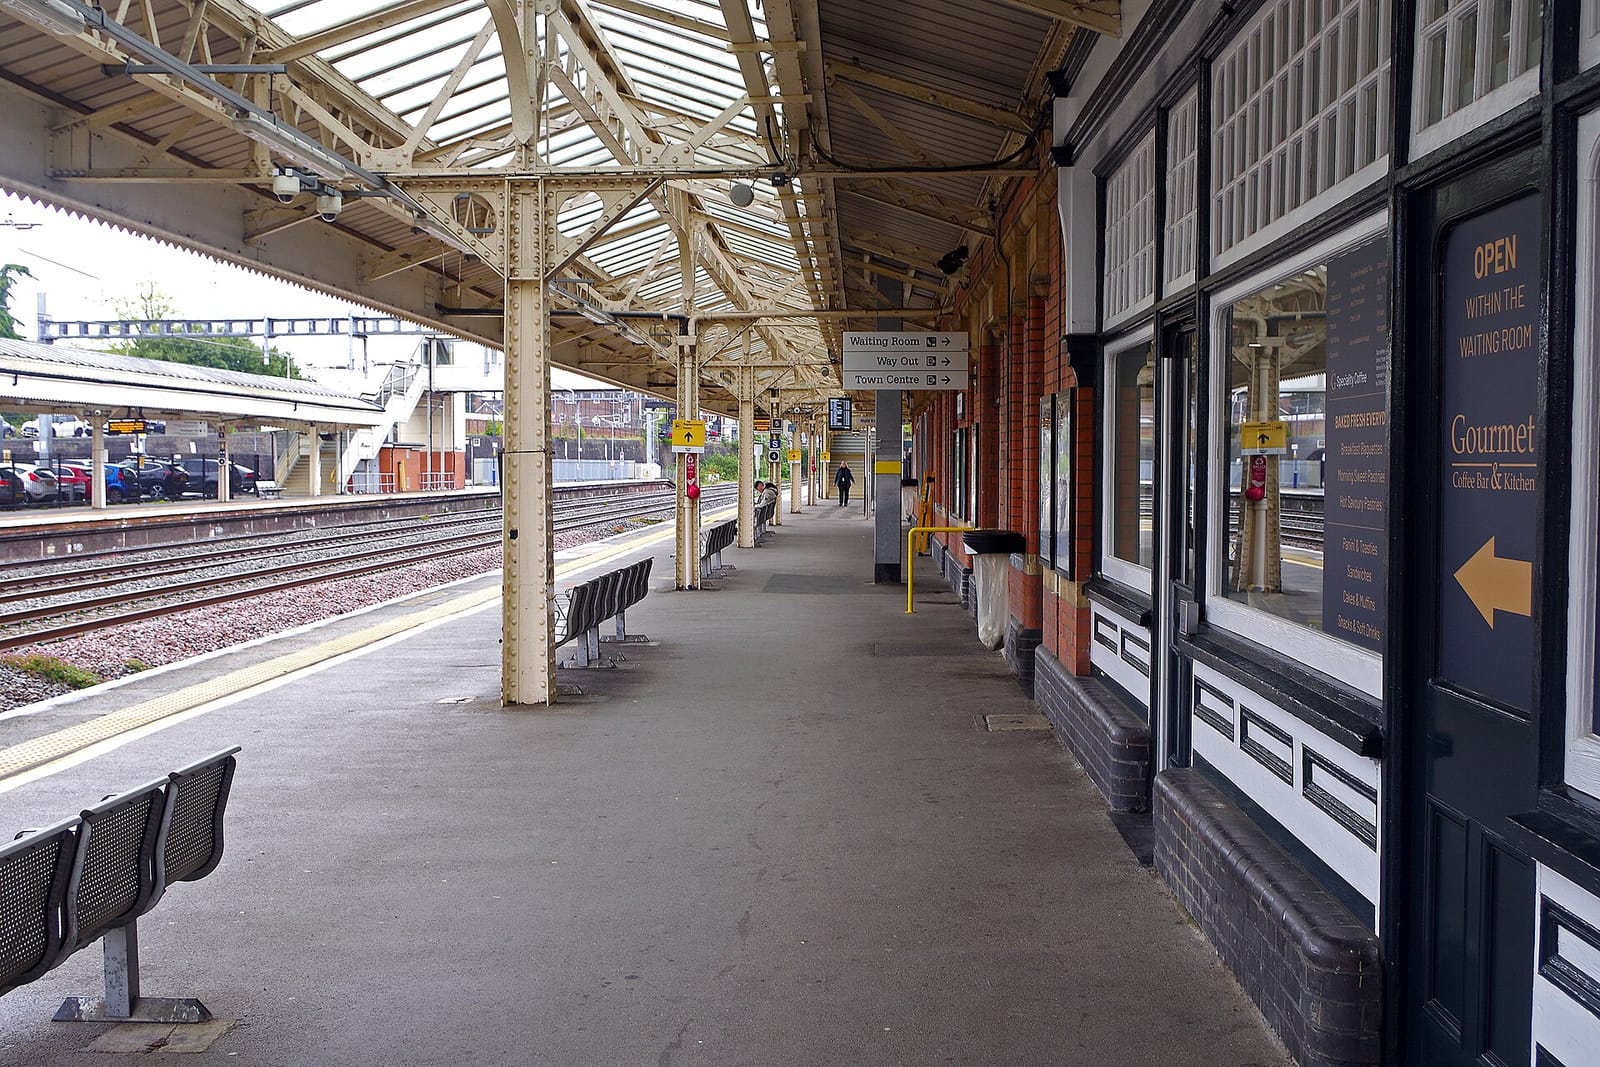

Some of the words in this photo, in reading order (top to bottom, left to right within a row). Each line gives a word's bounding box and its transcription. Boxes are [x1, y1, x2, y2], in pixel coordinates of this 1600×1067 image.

[1474, 234, 1516, 279] OPEN
[1466, 290, 1501, 320] WITHIN
[1504, 284, 1525, 311] THE
[850, 336, 888, 347] Waiting
[891, 336, 920, 346] Room
[1459, 330, 1500, 359] WAITING
[1502, 324, 1532, 351] ROOM
[876, 356, 898, 367] Way
[900, 356, 919, 366] Out
[855, 375, 883, 384] Town
[886, 375, 920, 384] Centre
[1354, 371, 1367, 385] Coffee
[1335, 414, 1350, 429] BAKED
[1350, 412, 1366, 428] FRESH
[1451, 413, 1535, 454] Gourmet
[1361, 442, 1383, 458] Baguettes
[1452, 471, 1475, 489] Coffee
[1476, 472, 1489, 489] Bar
[1490, 462, 1502, 490] &
[1504, 472, 1535, 491] Kitchen
[1339, 495, 1347, 508] Hot
[1364, 497, 1382, 511] Pastries
[1343, 537, 1355, 551] Panini
[1346, 564, 1372, 582] Sandwiches
[1343, 590, 1355, 606] Cakes
[1359, 594, 1376, 611] Muffins
[1337, 614, 1352, 631] Snacks
[1356, 620, 1366, 635] Soft
[1366, 623, 1381, 641] Drinks
